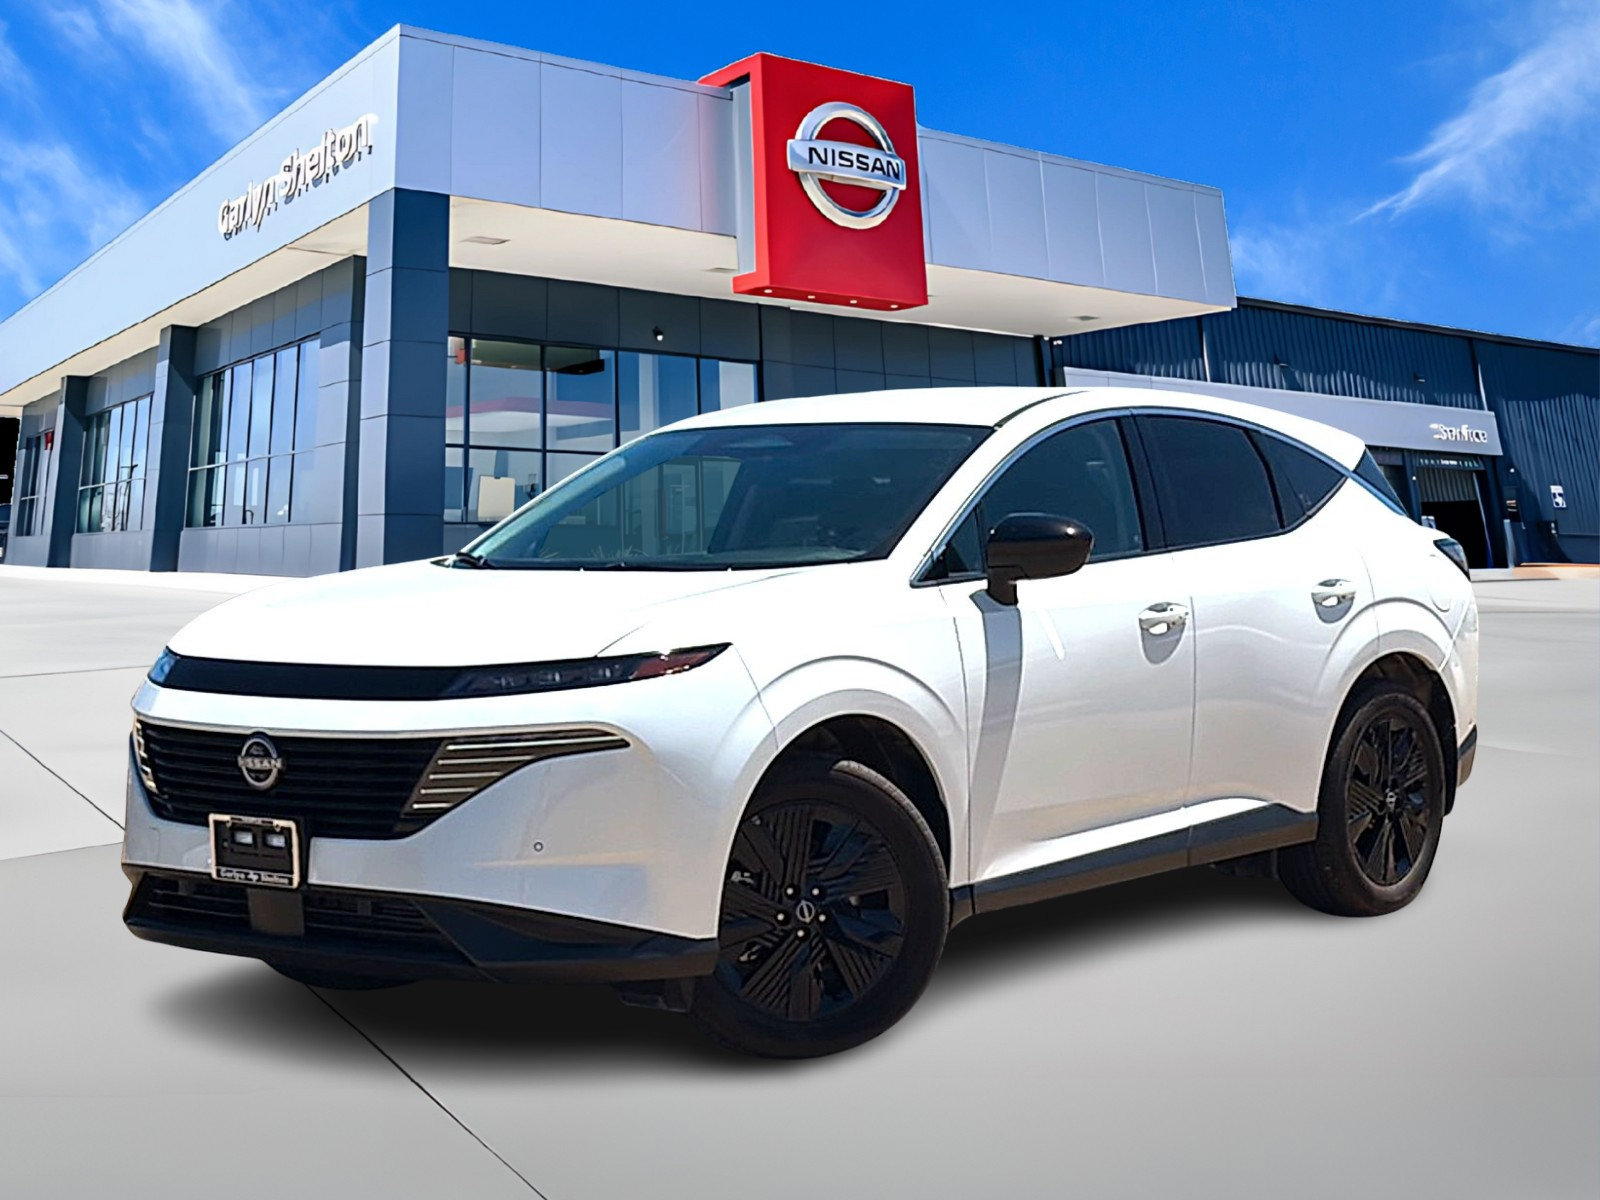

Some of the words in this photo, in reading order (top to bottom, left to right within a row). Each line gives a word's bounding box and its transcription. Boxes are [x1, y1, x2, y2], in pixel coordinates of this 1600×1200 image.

[279, 114, 376, 204] Shelton
[808, 147, 900, 180] NISSAN
[1429, 423, 1488, 443] Service
